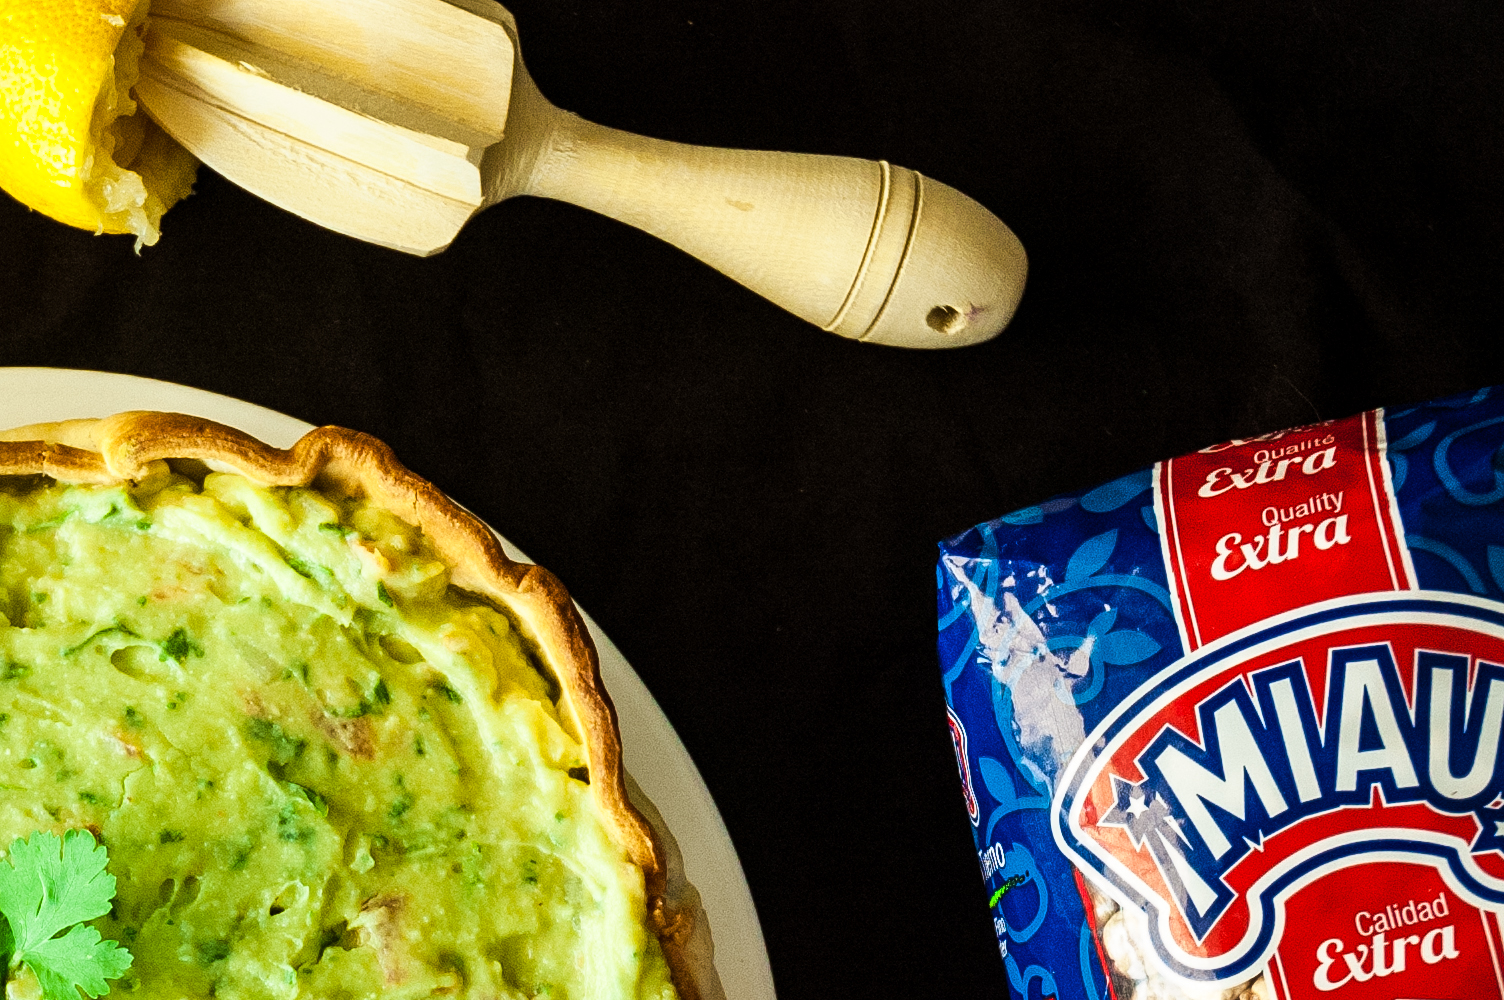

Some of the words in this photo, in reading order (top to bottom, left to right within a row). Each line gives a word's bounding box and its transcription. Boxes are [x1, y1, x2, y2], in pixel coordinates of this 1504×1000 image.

[1198, 446, 1337, 498] Extra
[1254, 434, 1335, 464] Qualité
[1261, 491, 1344, 526] Quality
[1210, 514, 1351, 581] Extra
[1111, 650, 1504, 928] ¡MIAU
[1355, 892, 1450, 936] Calidad
[1313, 925, 1460, 992] Extra
